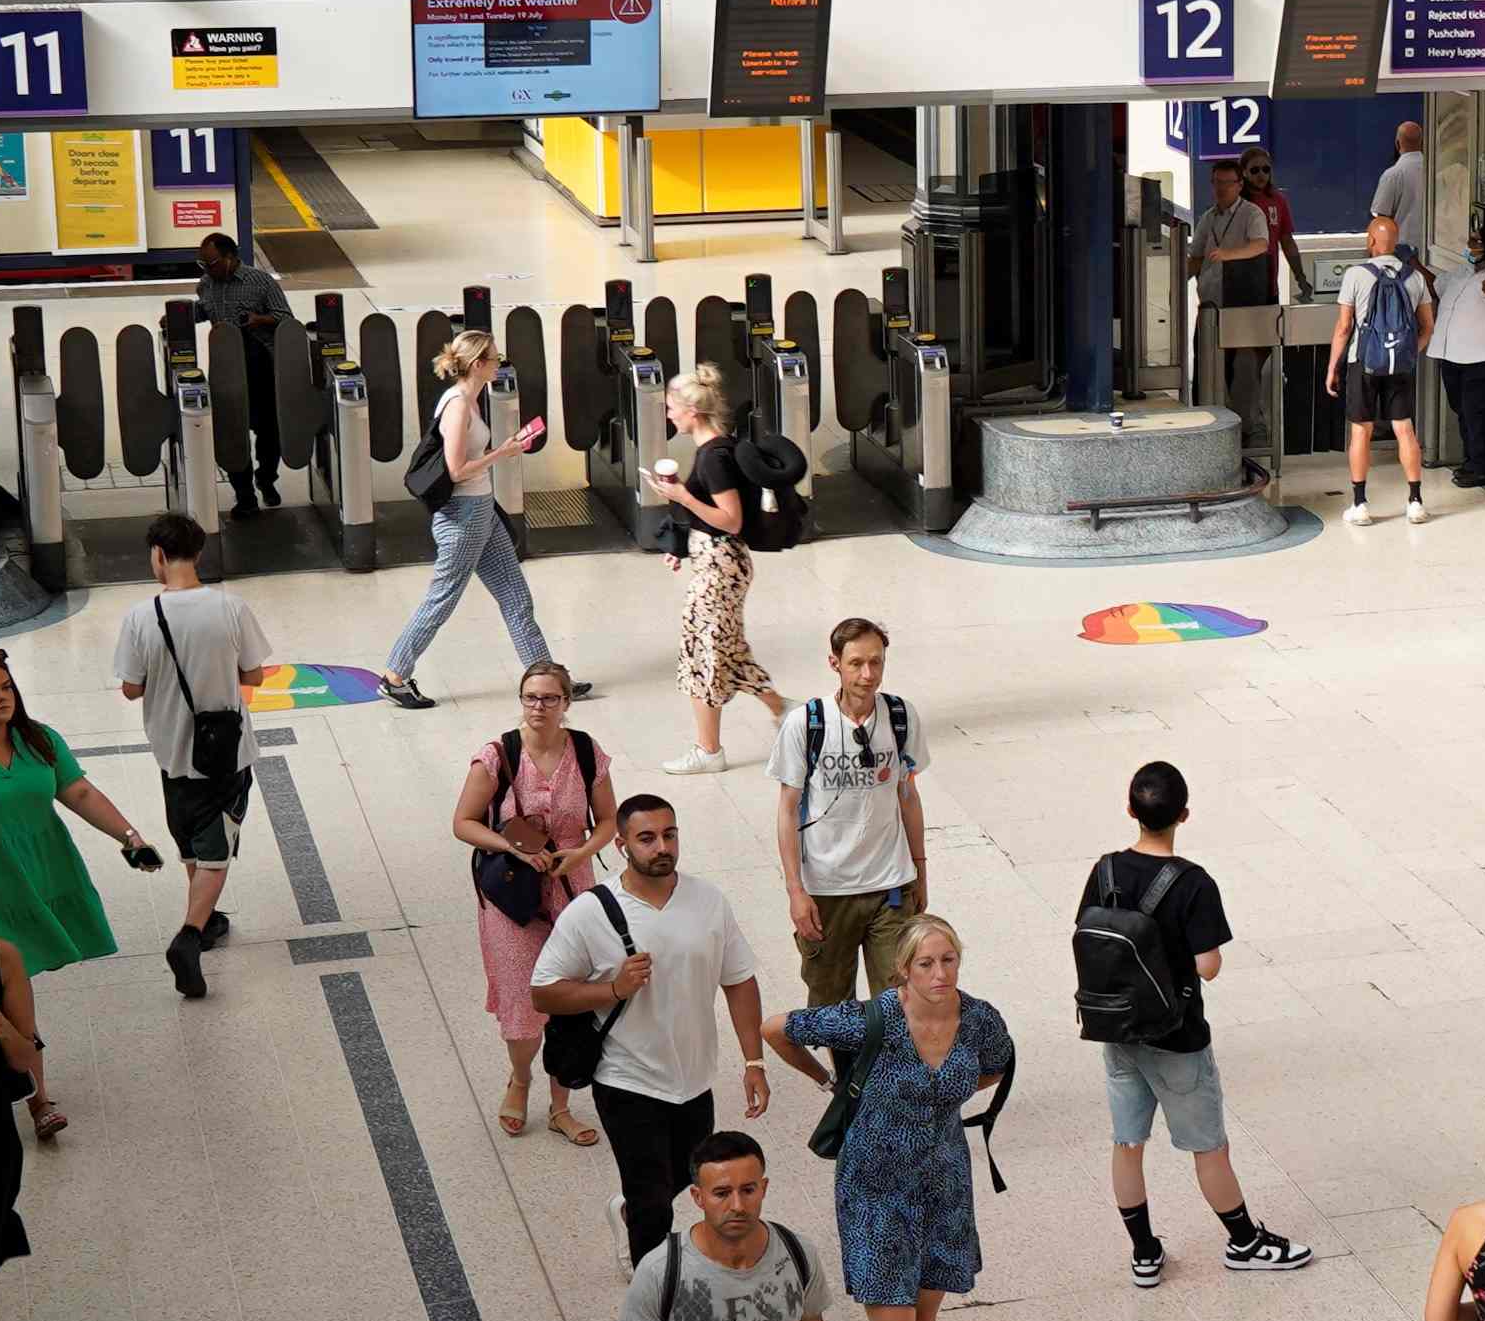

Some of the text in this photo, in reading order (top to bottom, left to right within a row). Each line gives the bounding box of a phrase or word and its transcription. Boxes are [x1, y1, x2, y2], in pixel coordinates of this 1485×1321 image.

[1428, 10, 1467, 22] Rejected
[1156, 0, 1222, 58] 12
[1428, 28, 1475, 38] Pushchairs
[207, 32, 263, 43] WARNING
[1428, 47, 1456, 59] Heavy
[0, 31, 62, 95] 11
[1210, 98, 1261, 145] 12
[68, 149, 120, 158] Doors close
[170, 127, 216, 173] 11
[70, 158, 119, 168] 30 seconds
[80, 167, 109, 178] before
[72, 177, 116, 186] departure
[823, 769, 875, 788] MARS
